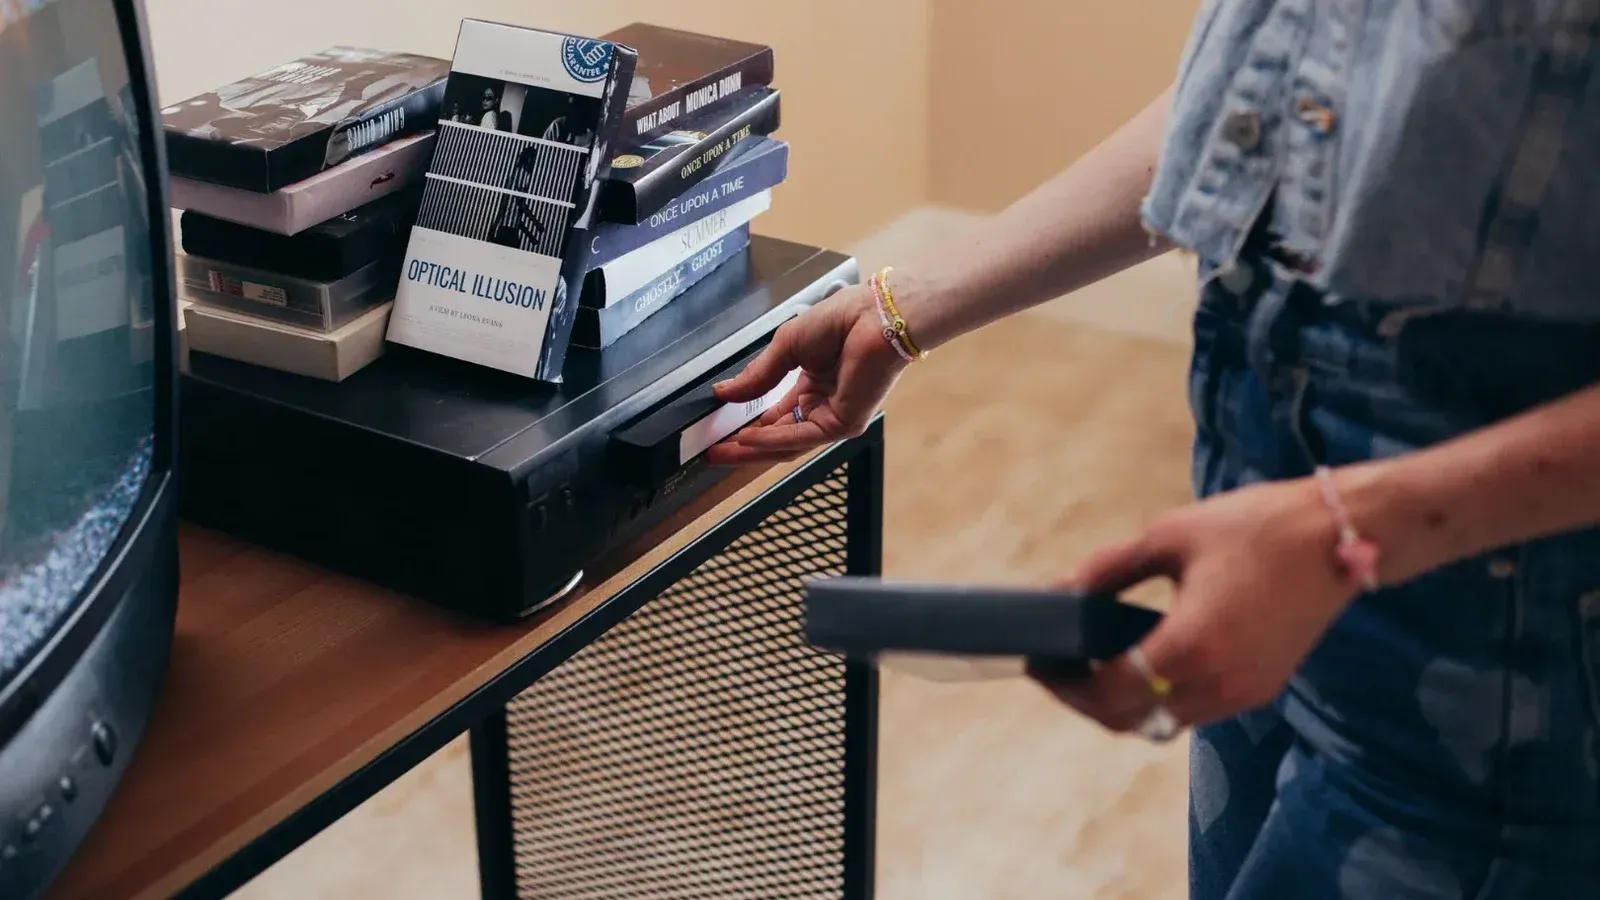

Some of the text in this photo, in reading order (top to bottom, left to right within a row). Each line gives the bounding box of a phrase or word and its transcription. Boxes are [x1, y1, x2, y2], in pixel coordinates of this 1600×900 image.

[567, 38, 601, 76] GUARANTEE
[636, 71, 742, 135] WHAT ABOUT MONICA DUNN
[681, 124, 751, 179] ONCE UPON A TIME
[650, 176, 745, 228] ONCE UPON A TIME
[680, 209, 728, 254] SUMMER
[408, 259, 547, 311] OPTICAL ILLUSION
[634, 239, 724, 312] GHOSTLY GHOST
